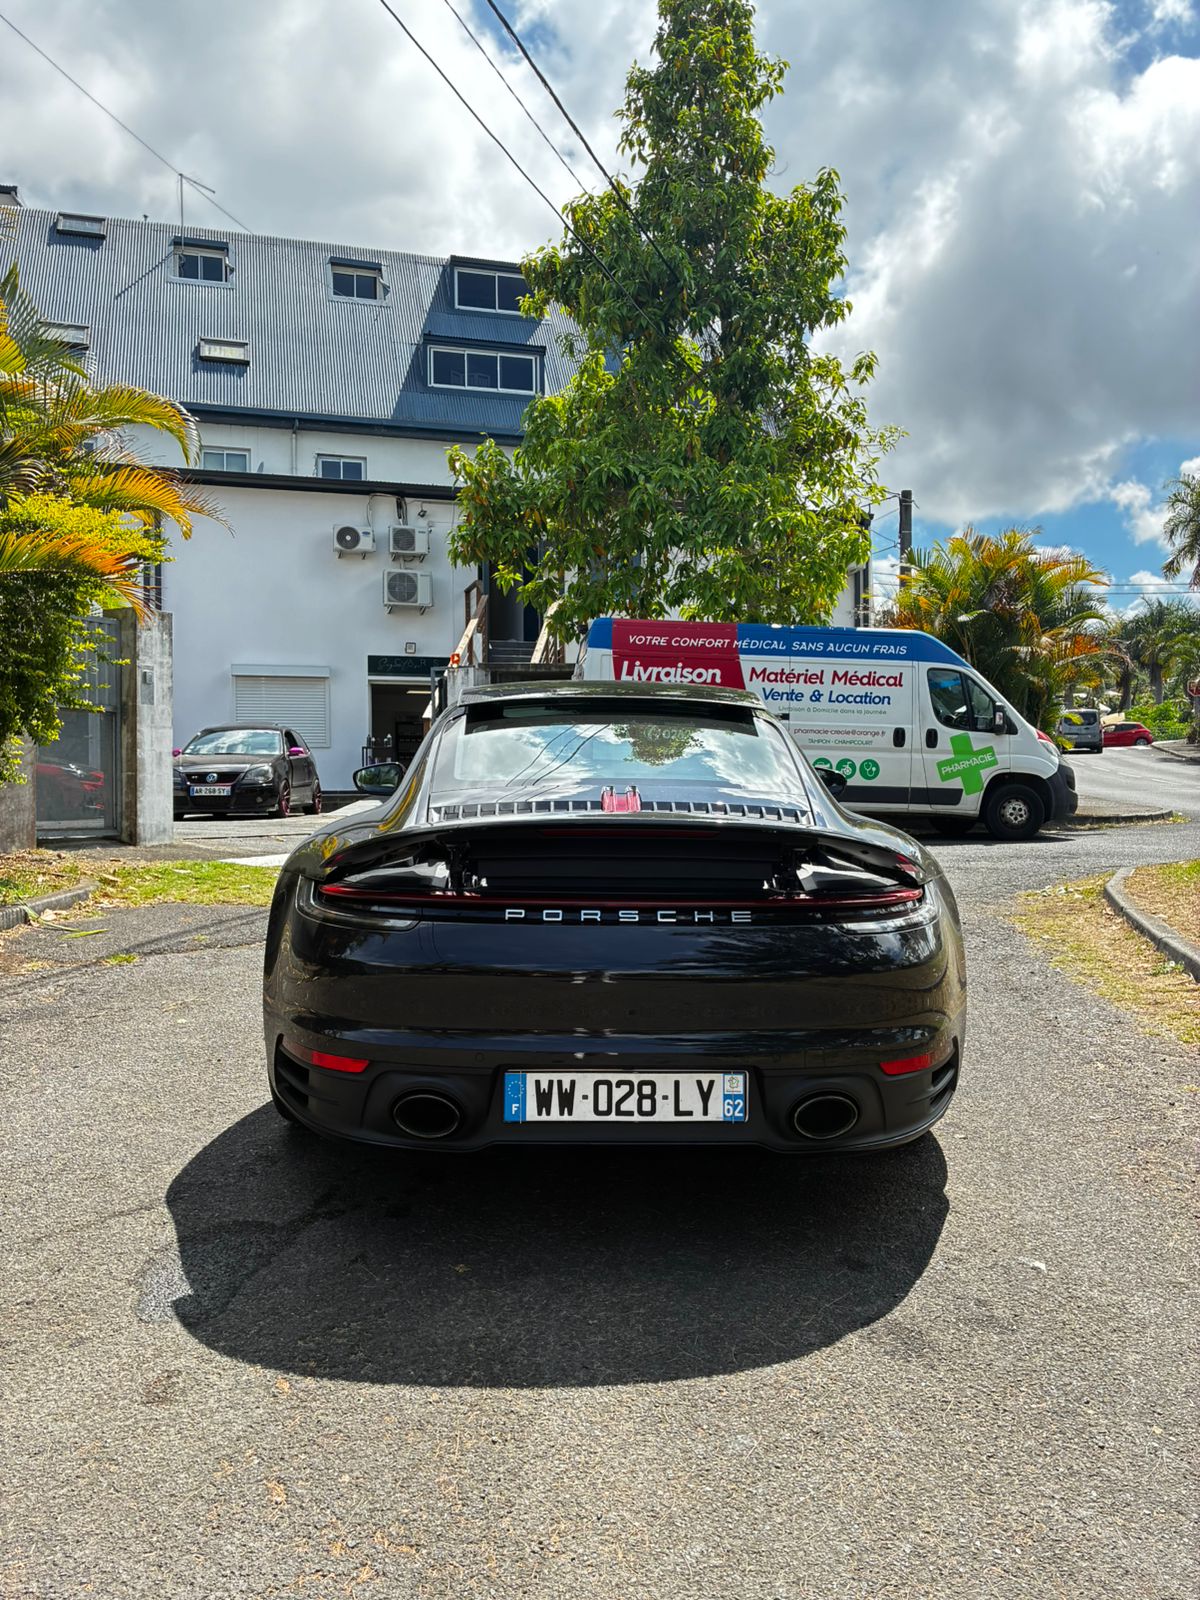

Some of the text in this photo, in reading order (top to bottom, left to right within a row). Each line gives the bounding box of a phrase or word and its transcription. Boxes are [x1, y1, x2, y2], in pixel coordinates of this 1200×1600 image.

[628, 635, 908, 655] VOTRE CONFORT MÉDICAL SANS AUCUN FRAIS
[620, 660, 722, 683] Livraison
[749, 667, 904, 688] Matériel Médical
[762, 687, 892, 705] Vente & Location
[812, 706, 838, 714] Domicile
[834, 738, 873, 746] CHAMPCOURT
[941, 752, 995, 775] PHARMACIE
[504, 908, 753, 923] PORSCHE
[534, 1079, 716, 1117] WW-028-LY
[511, 1104, 520, 1115] F
[723, 1099, 745, 1117] 62
